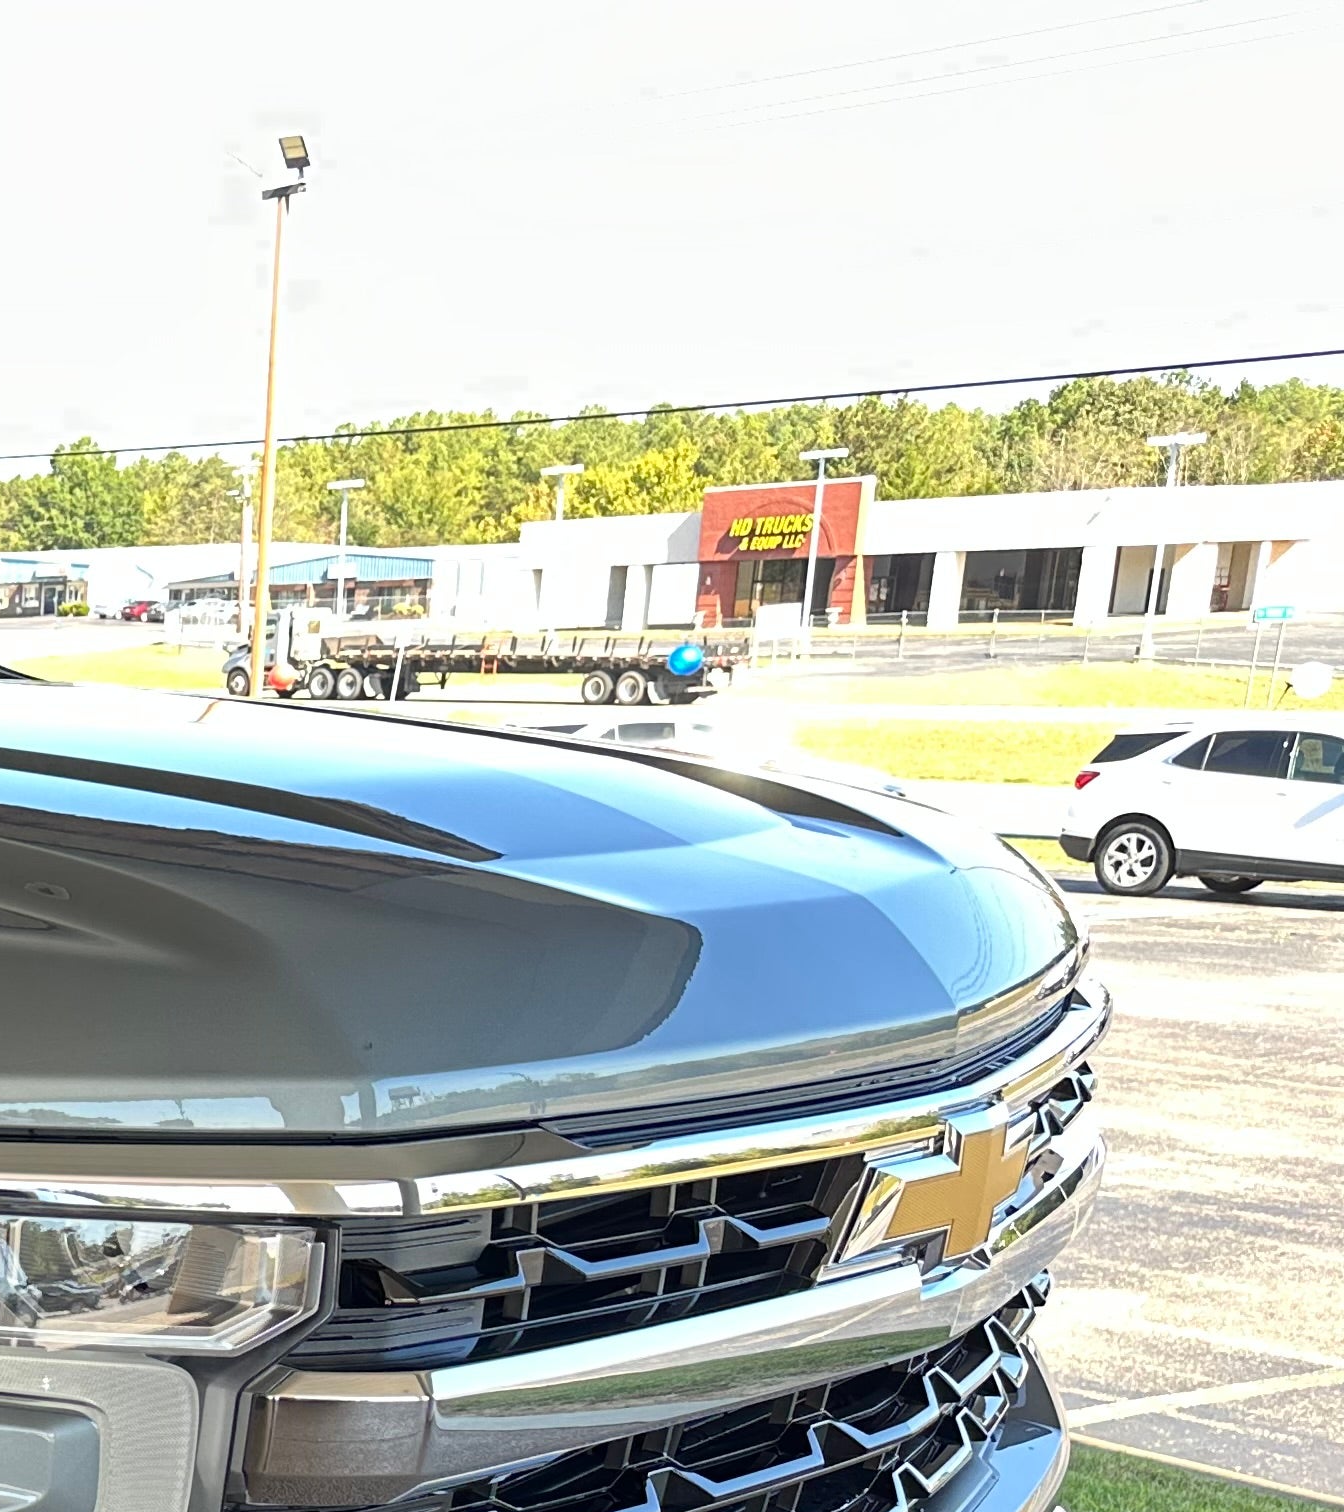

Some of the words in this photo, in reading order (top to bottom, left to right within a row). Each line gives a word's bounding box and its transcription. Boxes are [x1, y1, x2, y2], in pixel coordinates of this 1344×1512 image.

[730, 518, 752, 537] HD
[755, 514, 814, 535] TRUCKS
[739, 537, 749, 550] &
[750, 536, 782, 550] EQUIP
[782, 534, 806, 549] LLC
